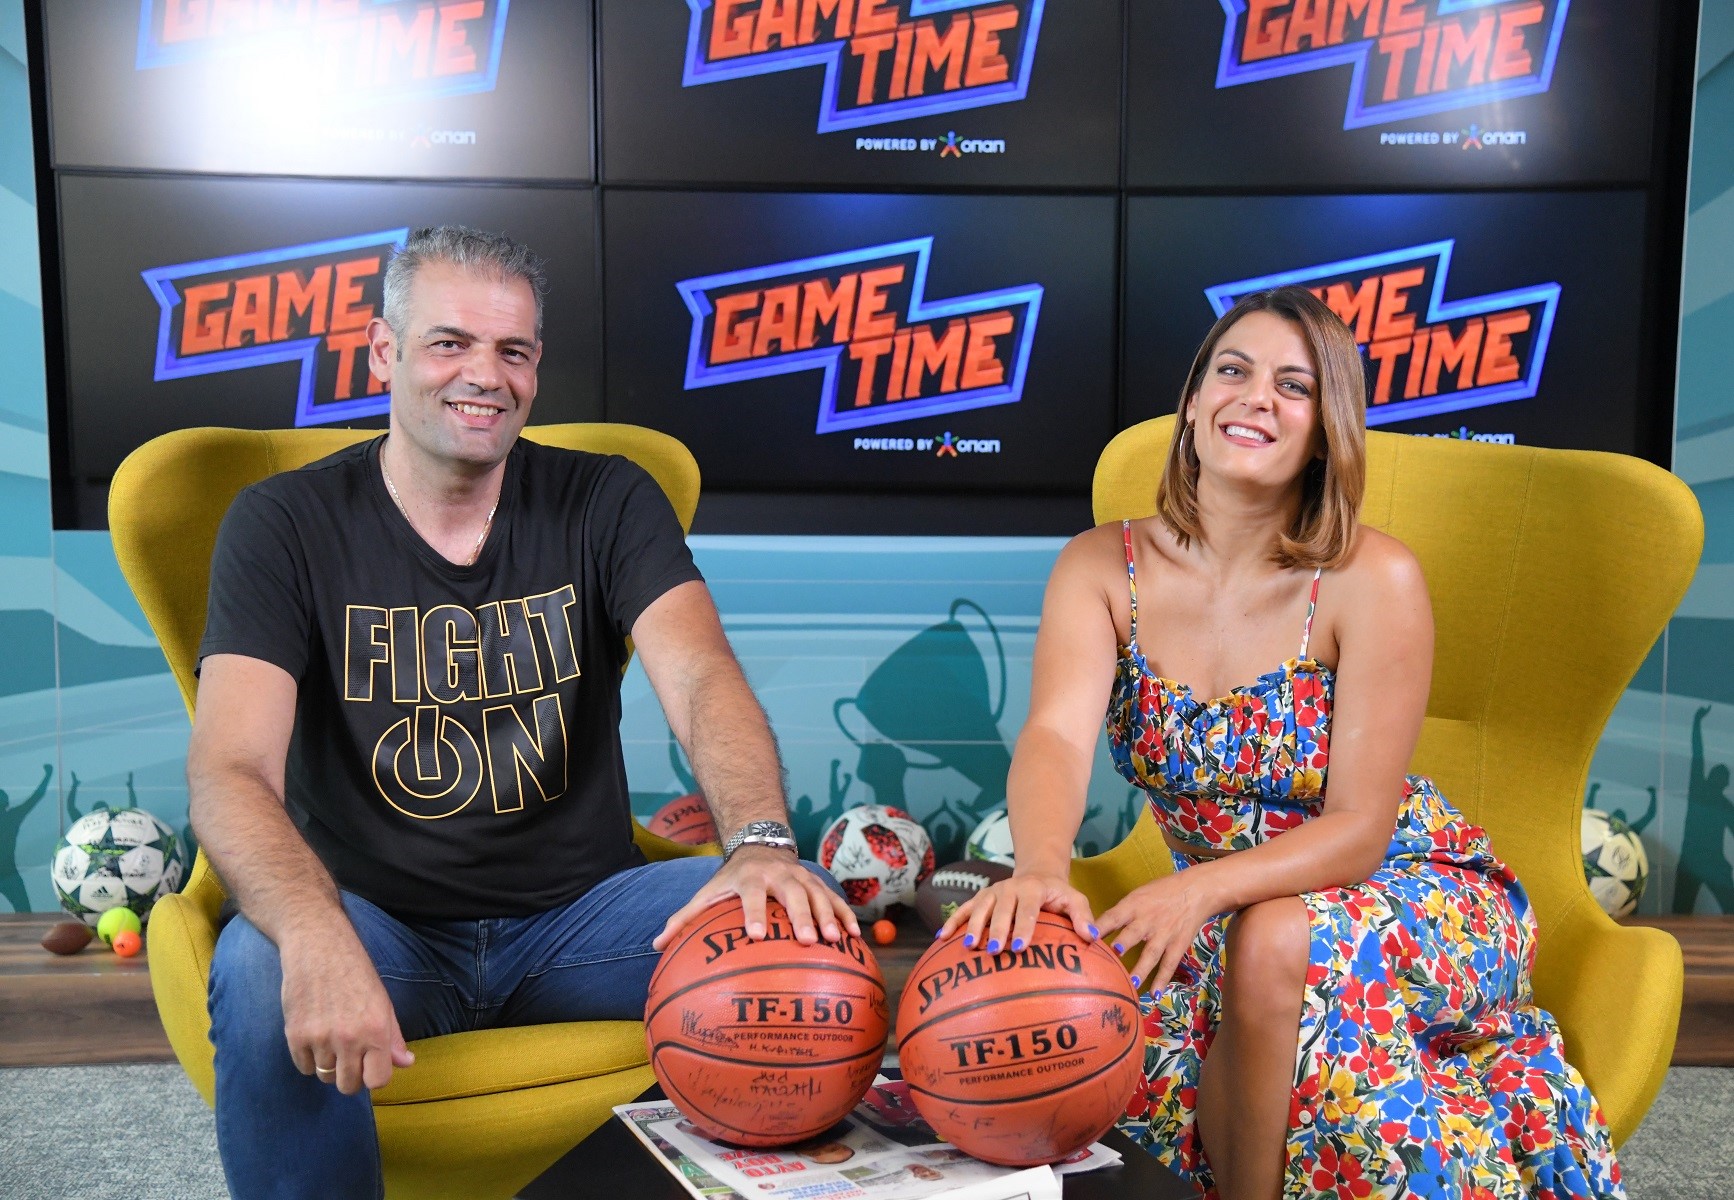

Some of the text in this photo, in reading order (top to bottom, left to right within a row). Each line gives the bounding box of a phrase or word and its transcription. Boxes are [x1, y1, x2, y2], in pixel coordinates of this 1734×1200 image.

[851, 4, 1019, 106] TIME
[1379, 0, 1544, 101] TIME
[855, 138, 917, 151] POWERED
[919, 138, 937, 151] BY
[1380, 132, 1440, 145] POWERED
[1442, 132, 1459, 145] BY
[181, 257, 380, 355] GAME
[709, 265, 905, 364] GAME
[1308, 267, 1425, 344] ME
[850, 310, 1014, 407] TIME
[1369, 309, 1531, 405] TIME
[853, 438, 914, 451] POWERED
[916, 438, 934, 451] BY
[345, 584, 581, 704] FIGHT
[372, 693, 568, 820] ON
[703, 922, 866, 966] SPLNG
[917, 943, 1083, 1015] SPALDING
[731, 997, 853, 1025] TF-150
[733, 1031, 853, 1043] PERFORMANCE OUTDOOR
[950, 1024, 1077, 1067] TF-150
[959, 1057, 1085, 1086] PERFORMANCE OUTDOOR
